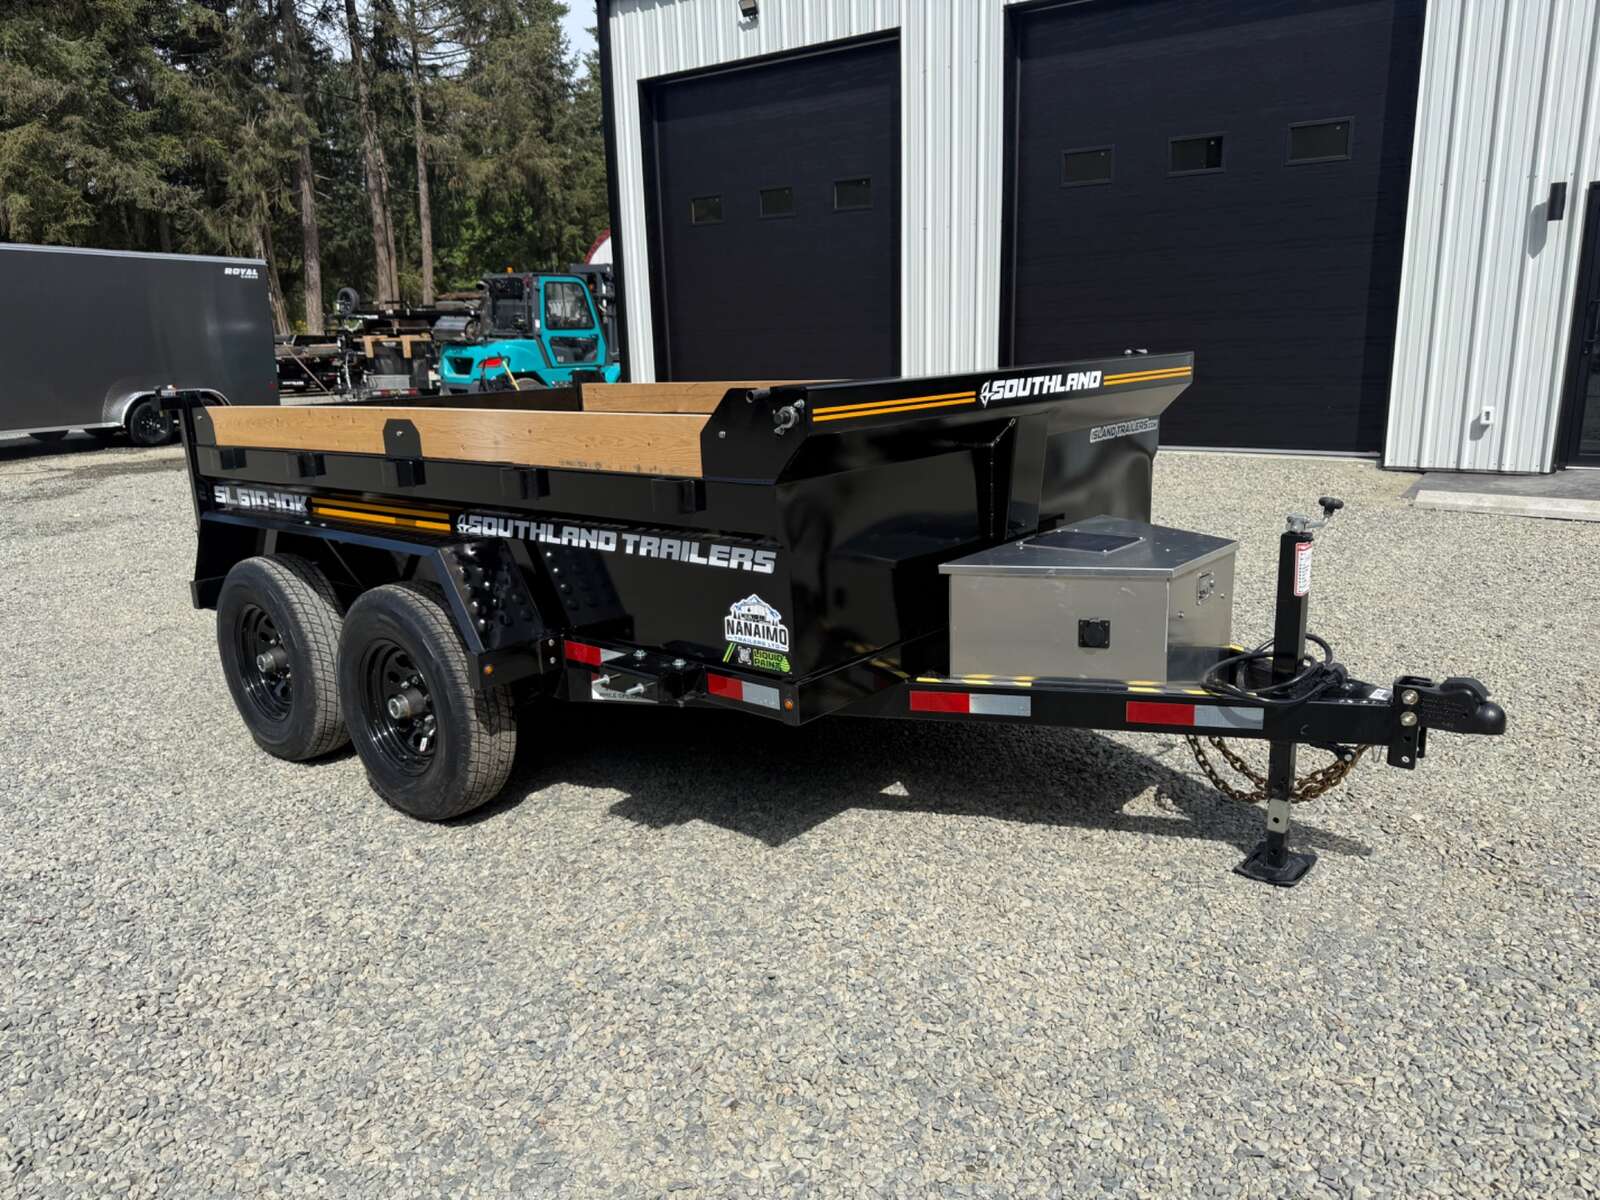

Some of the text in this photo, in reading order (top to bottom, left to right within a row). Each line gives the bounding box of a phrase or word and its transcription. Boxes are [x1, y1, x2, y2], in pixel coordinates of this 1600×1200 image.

[224, 267, 258, 275] ROYAL
[990, 370, 1102, 400] SOUTHLAND
[214, 486, 308, 512] SL610-10K
[468, 515, 777, 574] SOUTHLAND TRAILERS
[726, 619, 787, 646] NANAIMO
[753, 649, 784, 662] LIQUID
